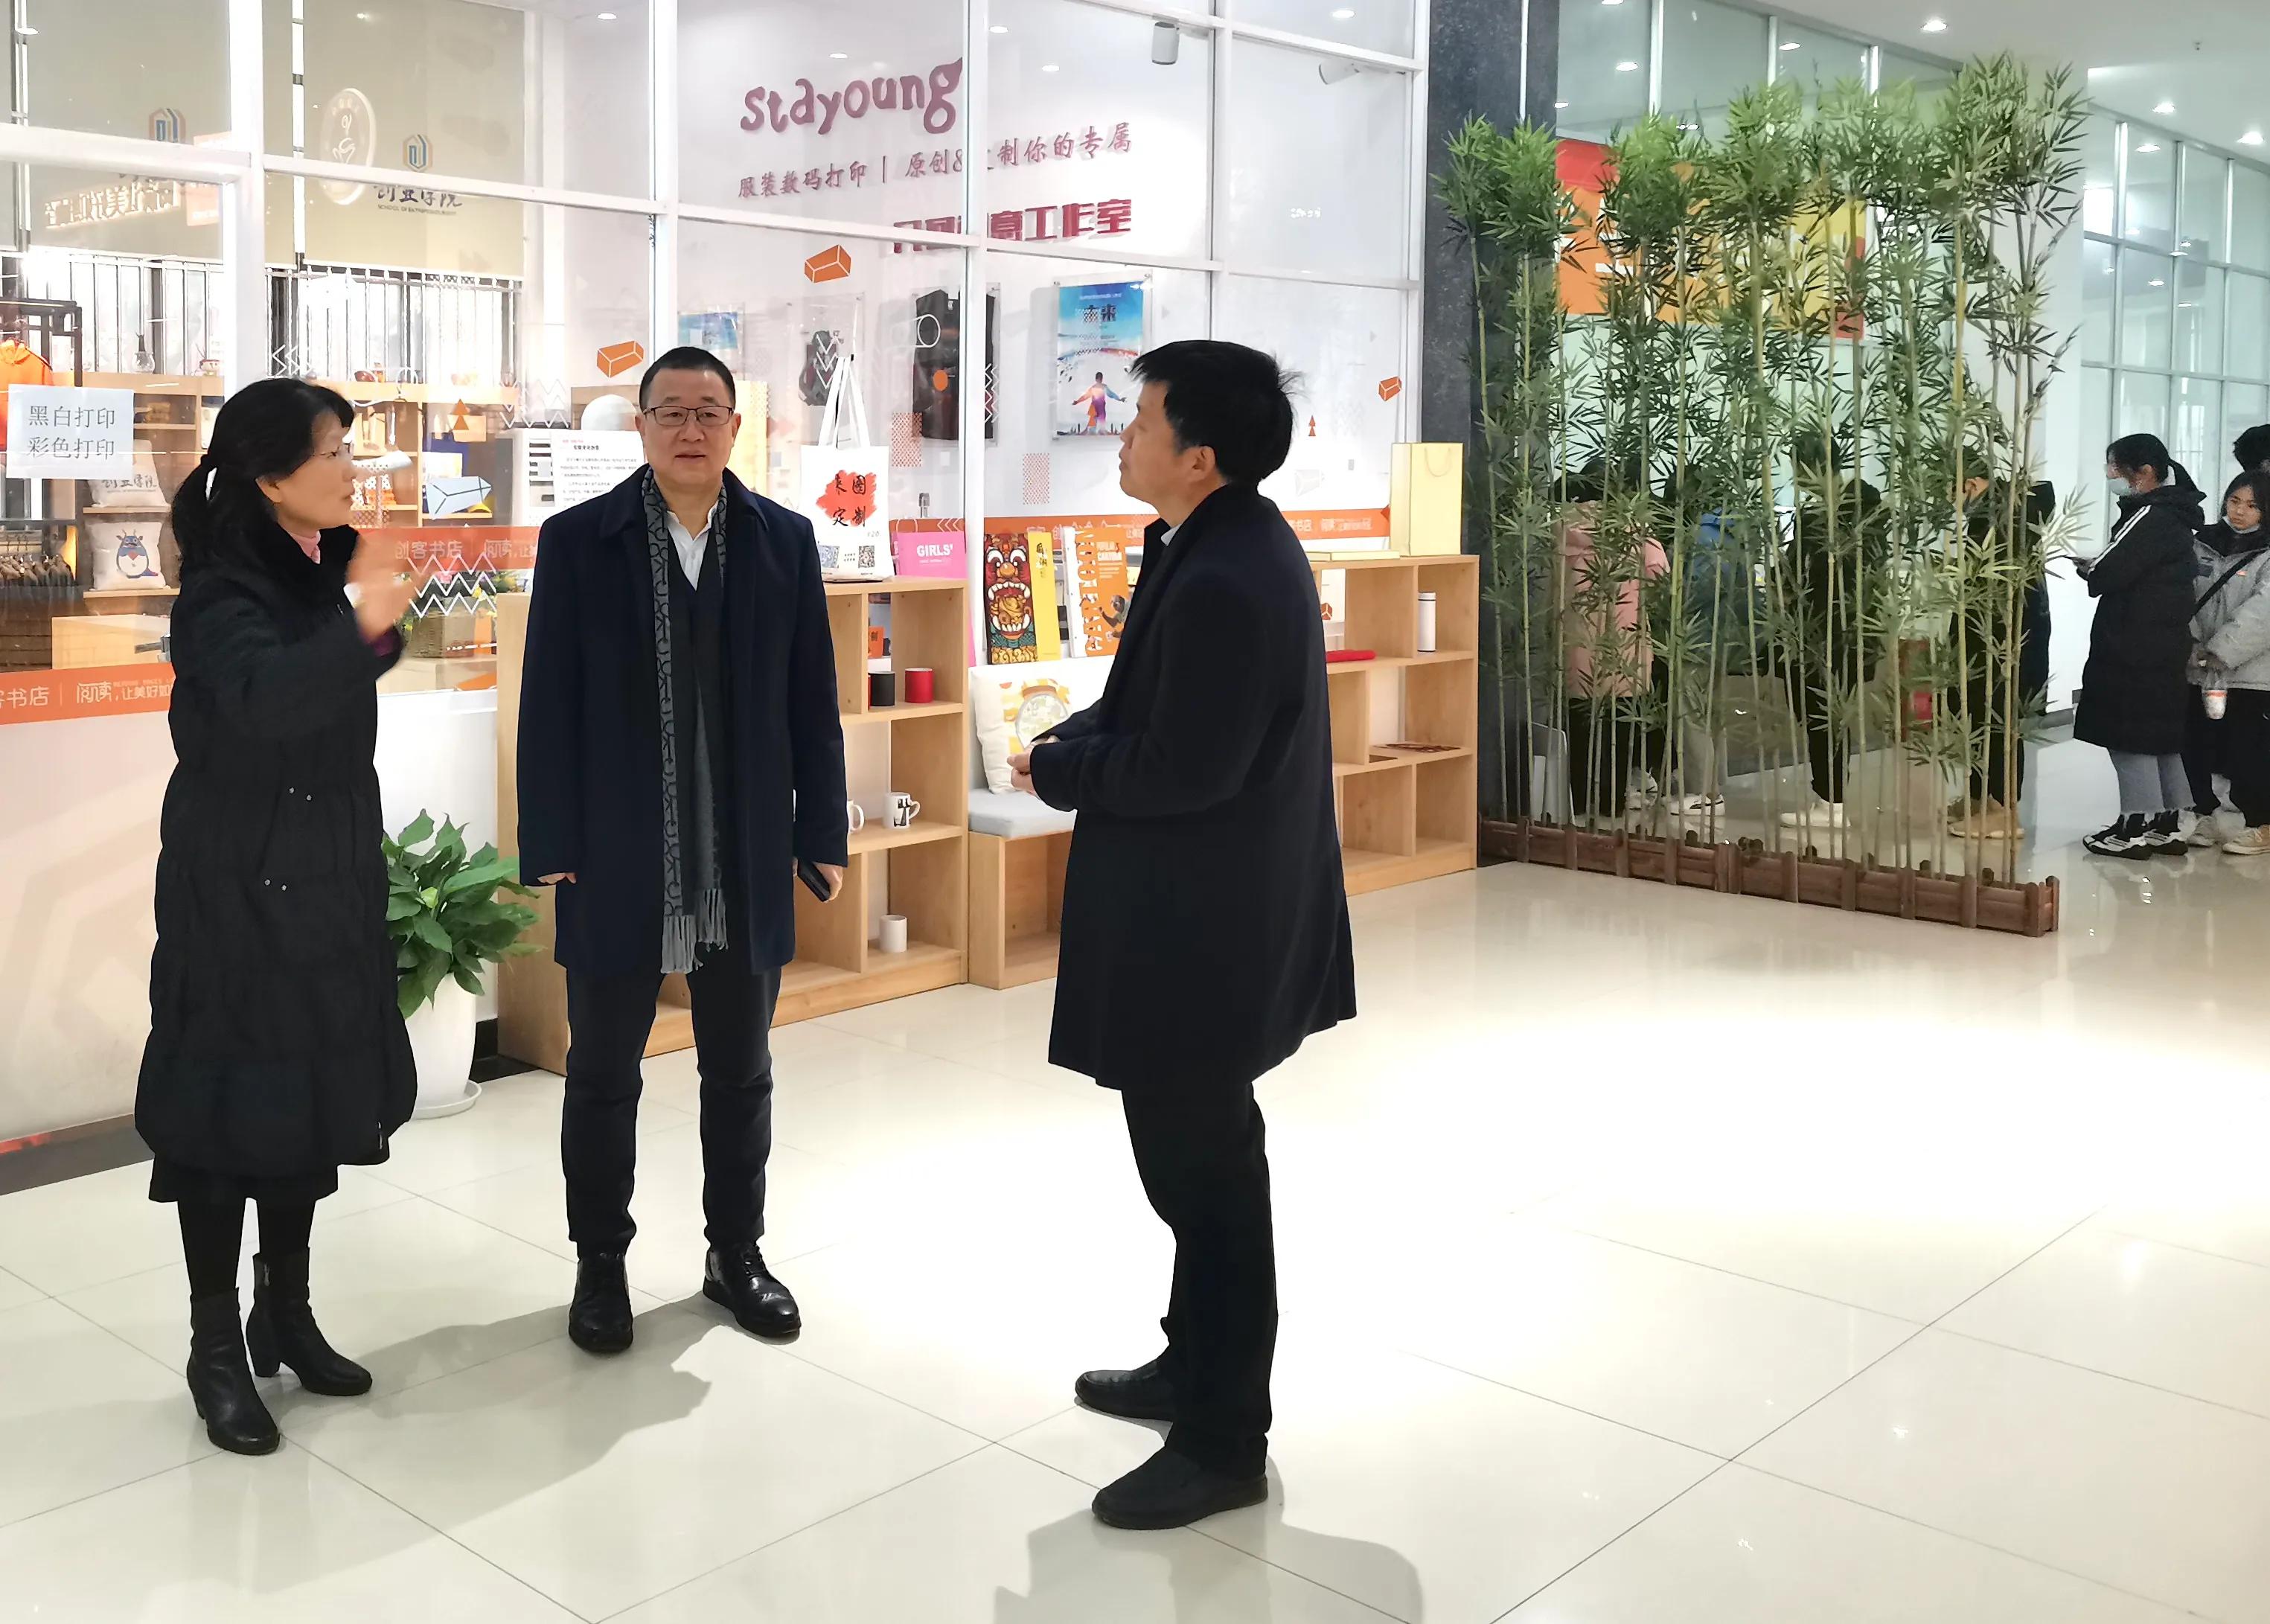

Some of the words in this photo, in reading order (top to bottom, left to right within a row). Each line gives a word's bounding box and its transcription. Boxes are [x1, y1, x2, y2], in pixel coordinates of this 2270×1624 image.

[738, 160, 868, 199] 服装数码打印
[28, 405, 115, 429] 黑白打印
[28, 436, 115, 460] 彩色打印
[833, 506, 866, 527] 定制
[0, 685, 50, 709] 书店
